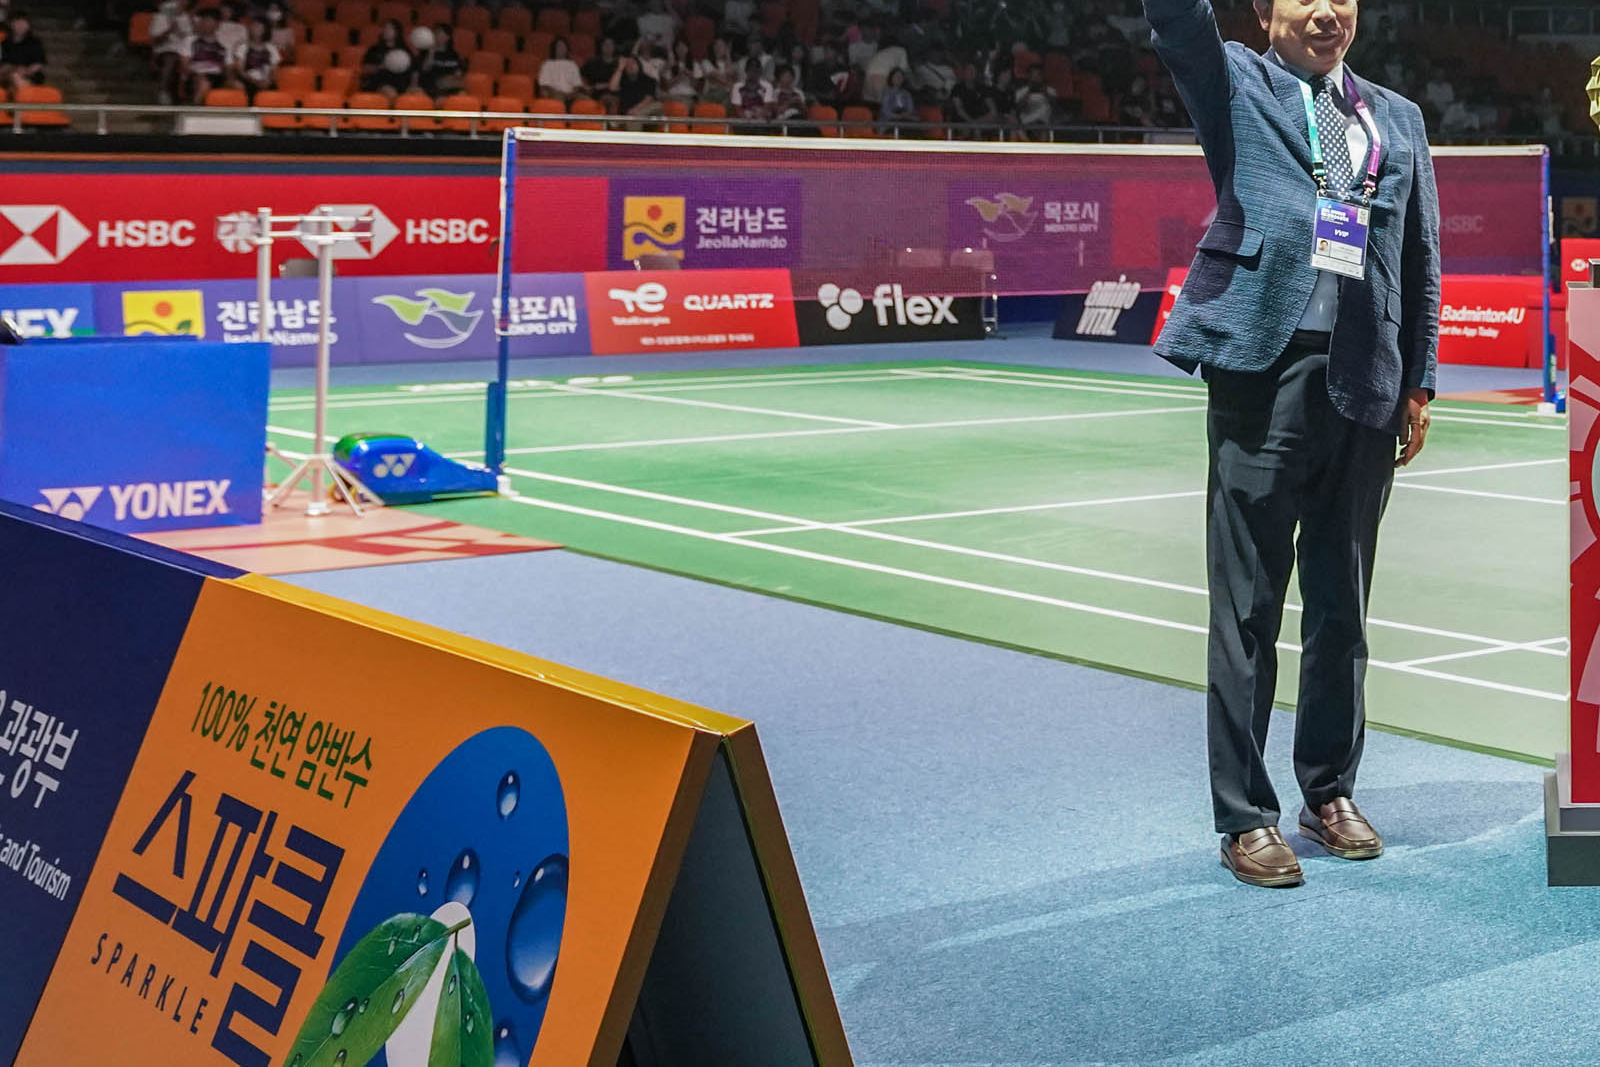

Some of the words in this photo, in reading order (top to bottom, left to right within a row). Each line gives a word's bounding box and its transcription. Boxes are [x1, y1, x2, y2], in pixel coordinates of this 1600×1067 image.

[696, 206, 788, 234] 전라남도
[1044, 201, 1099, 223] 목포시
[97, 220, 197, 248] HSBC
[404, 218, 489, 245] HSBC
[696, 235, 788, 250] JeollaNamdo
[683, 293, 774, 311] QUARTZ
[872, 283, 959, 326] flex
[1441, 304, 1526, 325] Badminton4U
[547, 321, 578, 335] CITY
[109, 479, 231, 521] YONEX
[0, 690, 79, 809] 관광부
[191, 681, 258, 752] 100%
[249, 700, 307, 779] 천연
[295, 720, 373, 809] 암반수
[1, 837, 30, 872] and
[22, 844, 72, 901] Tourism
[112, 769, 346, 1067] 스파클
[90, 933, 208, 1034] SPARKLE
